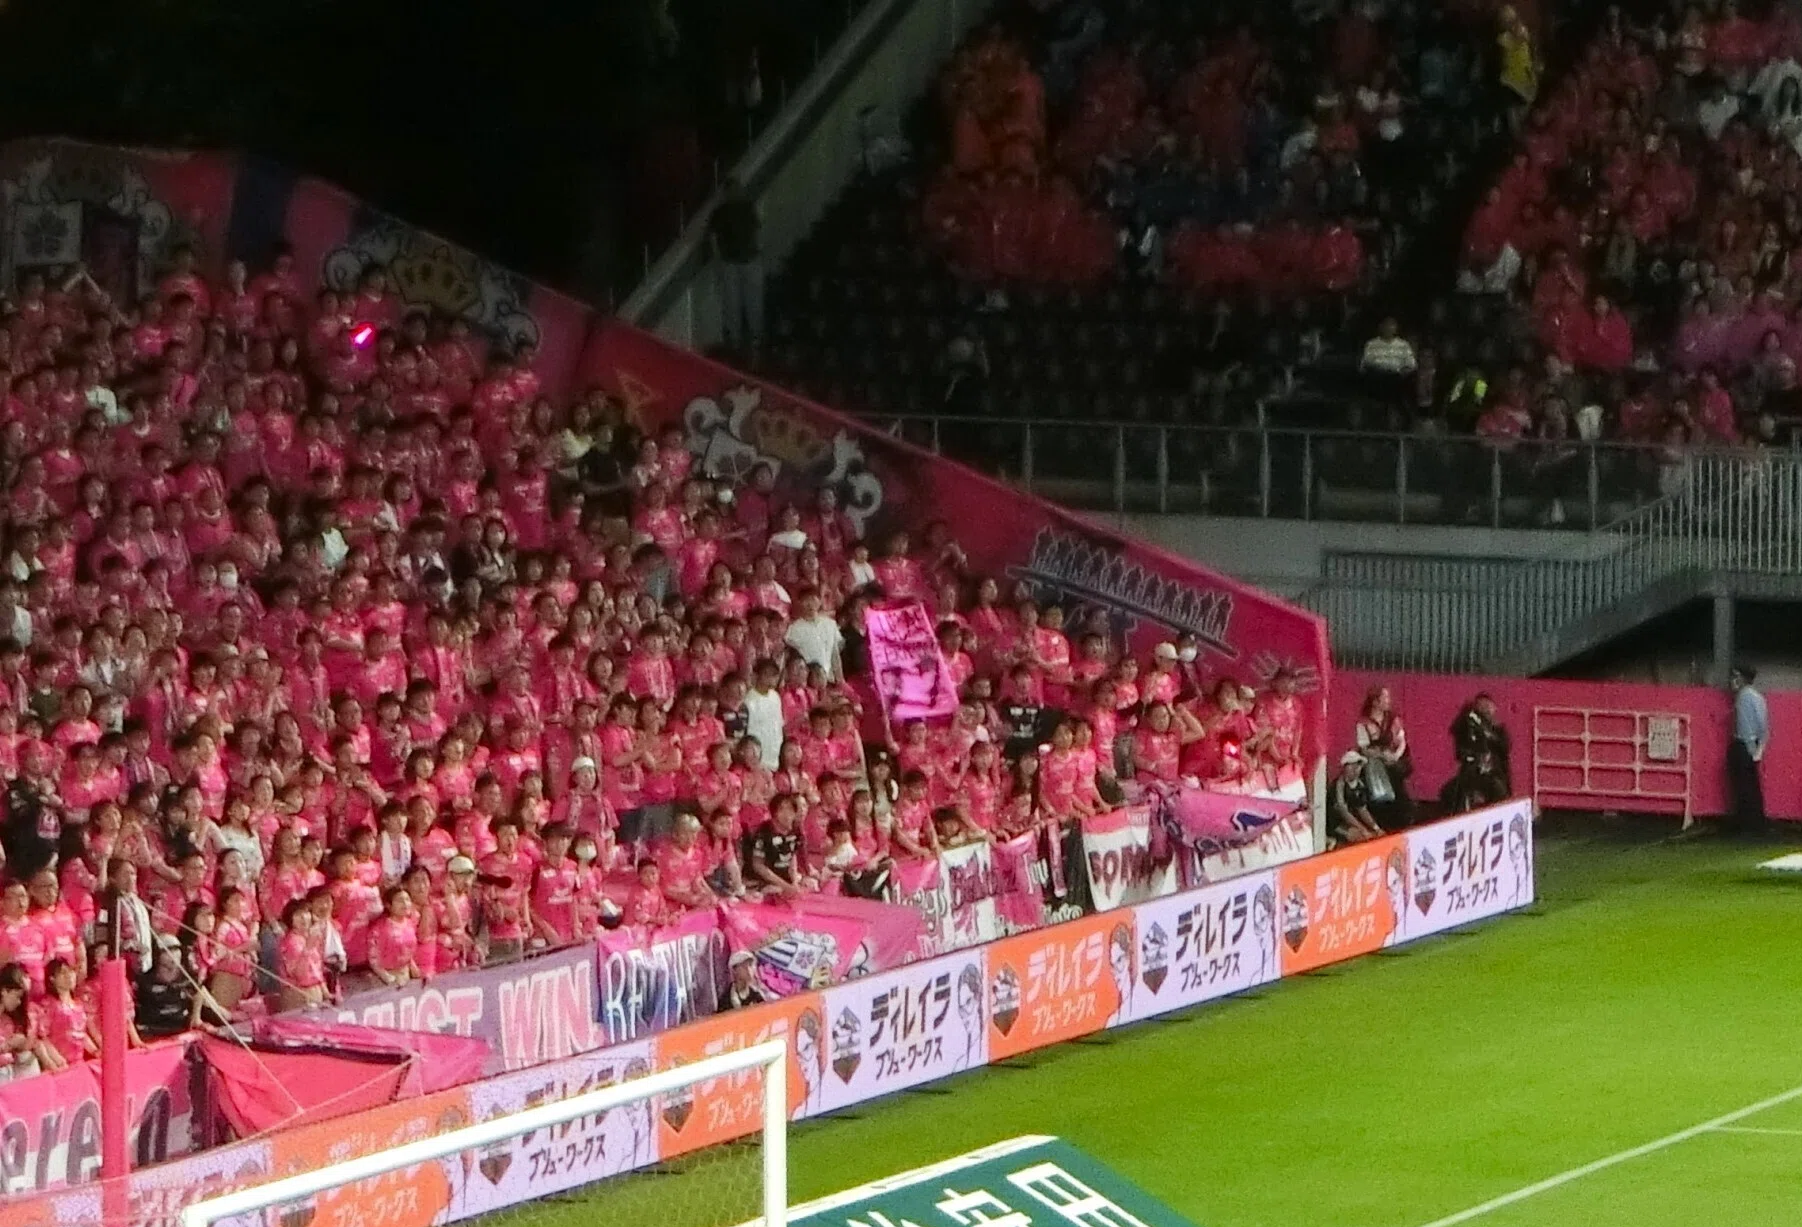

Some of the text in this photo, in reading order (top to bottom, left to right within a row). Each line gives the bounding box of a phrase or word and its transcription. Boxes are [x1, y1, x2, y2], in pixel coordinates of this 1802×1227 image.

[1443, 822, 1504, 884] ディレイラ
[1315, 856, 1382, 923] ディレイラ
[1176, 891, 1248, 961] ディレイラ
[1026, 931, 1102, 1003] ディレイラ
[870, 973, 951, 1047] ディレイラ
